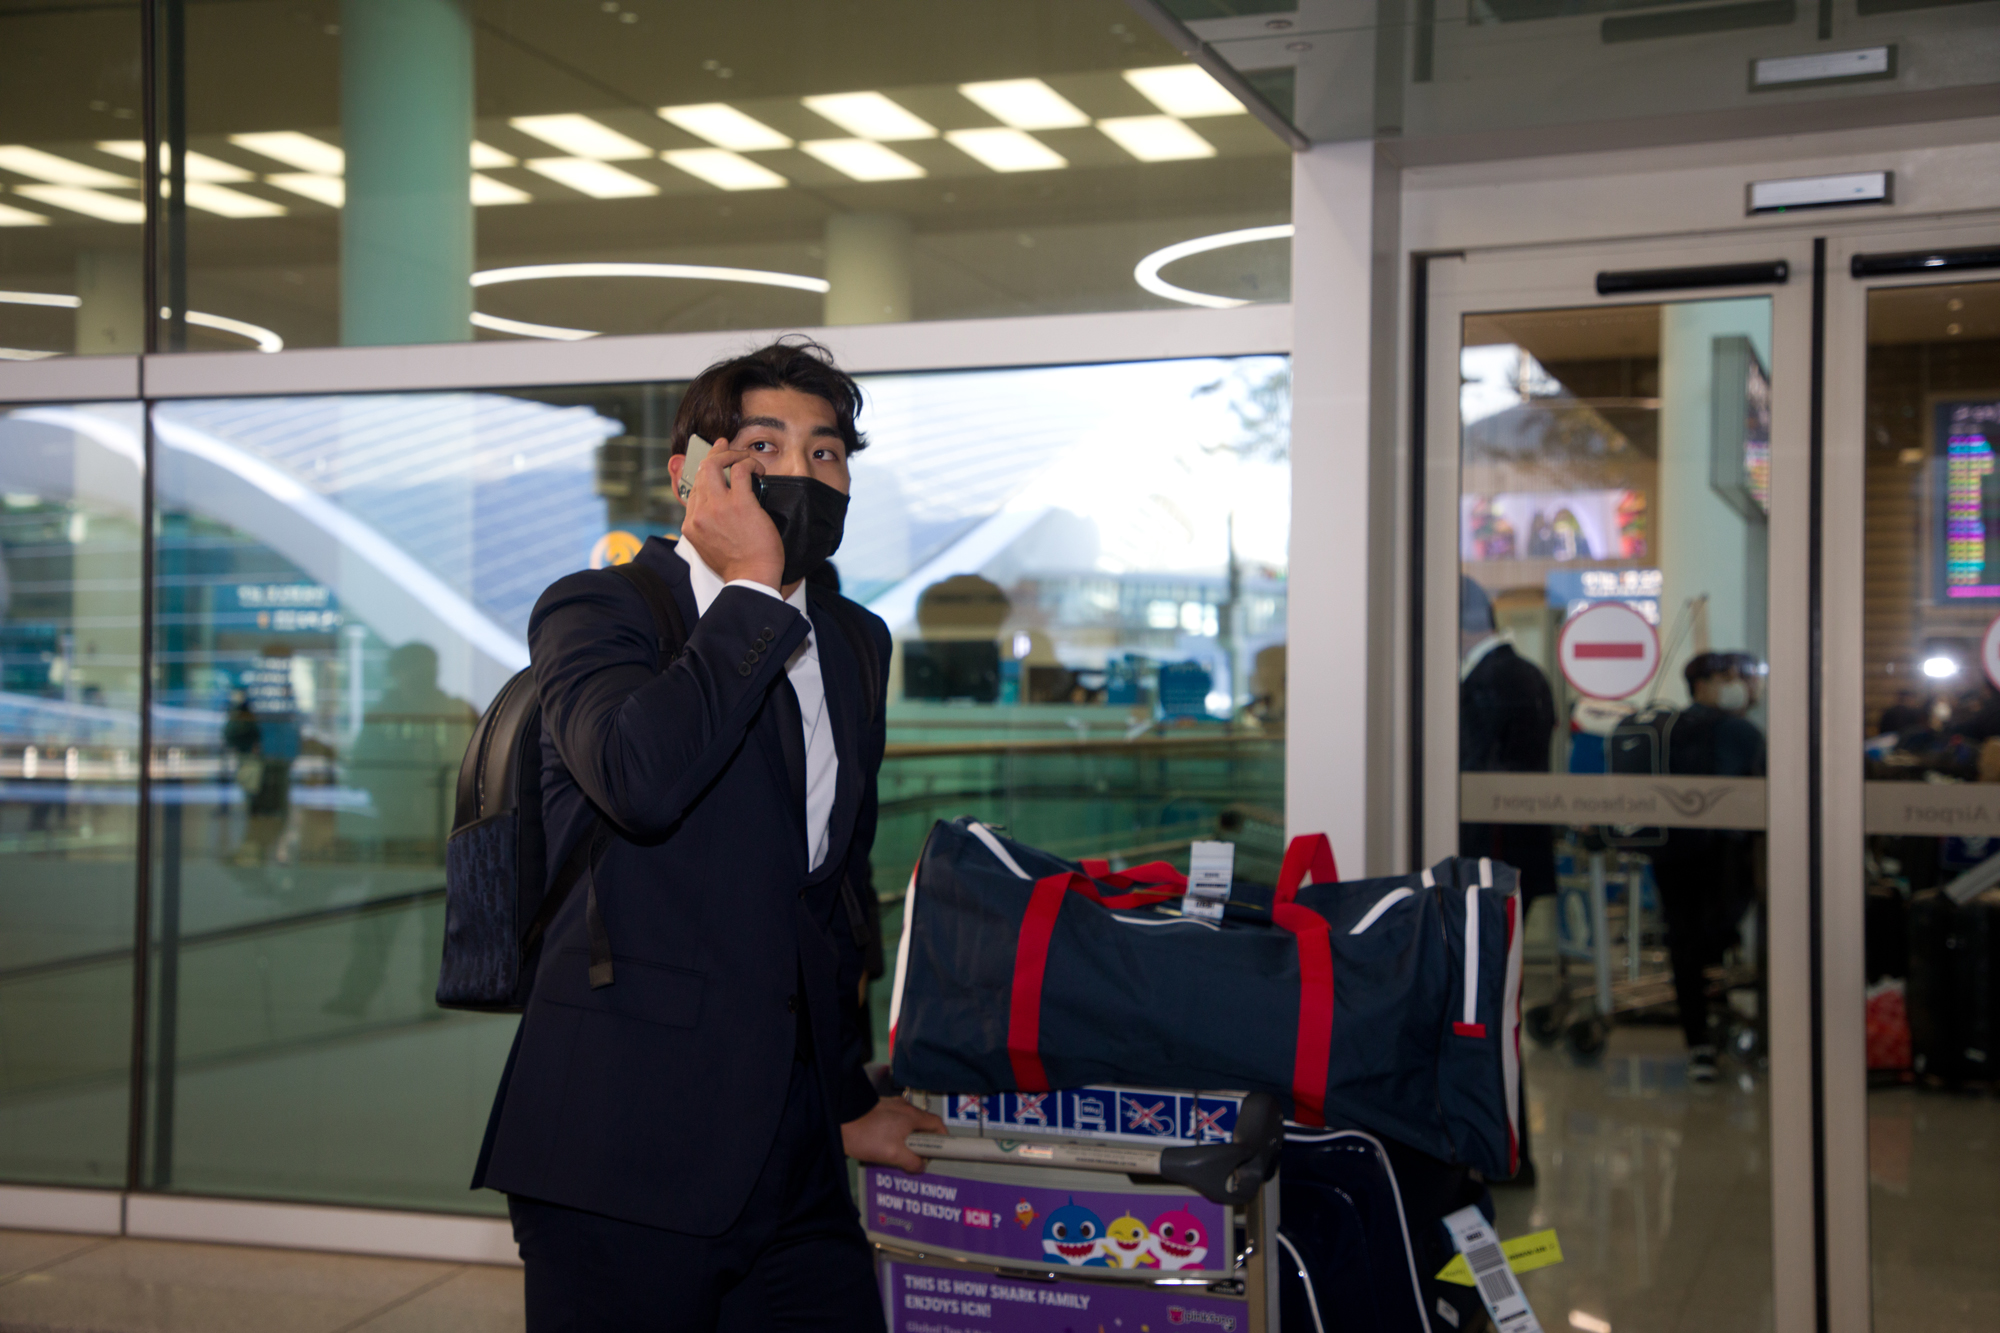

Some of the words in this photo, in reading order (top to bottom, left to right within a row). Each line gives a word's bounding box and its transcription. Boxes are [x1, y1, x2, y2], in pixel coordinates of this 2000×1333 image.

[876, 1173, 893, 1189] DO
[893, 1177, 919, 1194] YOU
[920, 1182, 957, 1201] KNOW
[876, 1193, 904, 1211] HOW
[905, 1198, 921, 1214] TO
[922, 1203, 961, 1222] ENJOY
[904, 1274, 935, 1291] THIS
[937, 1278, 951, 1293] IS
[953, 1280, 988, 1297] HOW
[990, 1284, 1036, 1303] SHARK
[1038, 1290, 1090, 1310] FAMILY
[905, 1294, 959, 1315] ENJOYS
